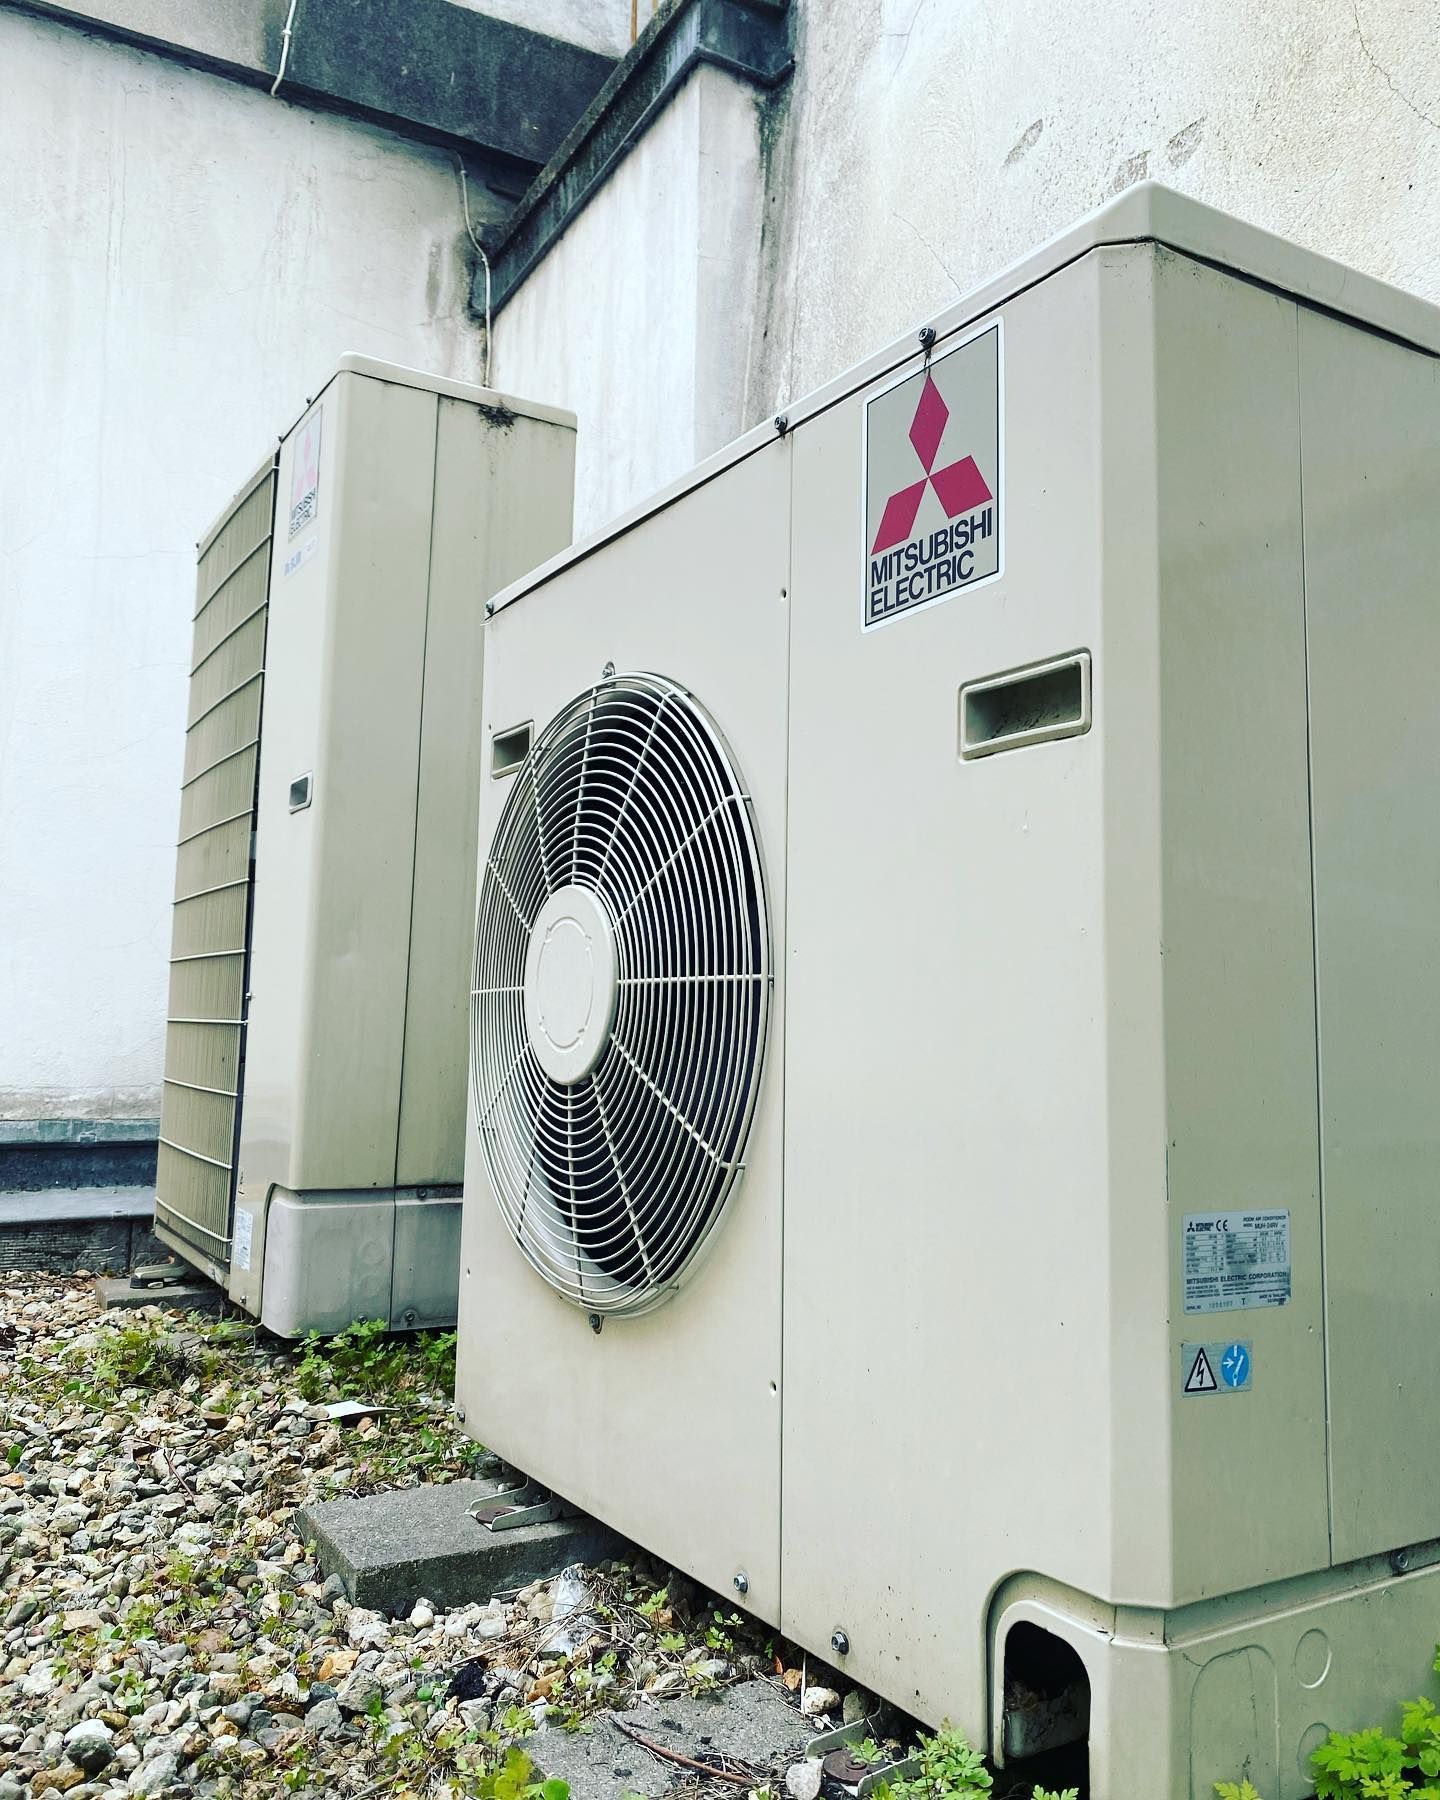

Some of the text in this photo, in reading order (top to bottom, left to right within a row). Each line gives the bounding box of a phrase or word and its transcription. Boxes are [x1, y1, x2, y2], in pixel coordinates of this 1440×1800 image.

[871, 507, 992, 588] MITSUBISHI
[871, 550, 974, 617] ELECTRIC
[1215, 1219, 1228, 1232] CE
[1186, 1271, 1287, 1285] MITSUBISHI ELECTRIC CORPORATION
